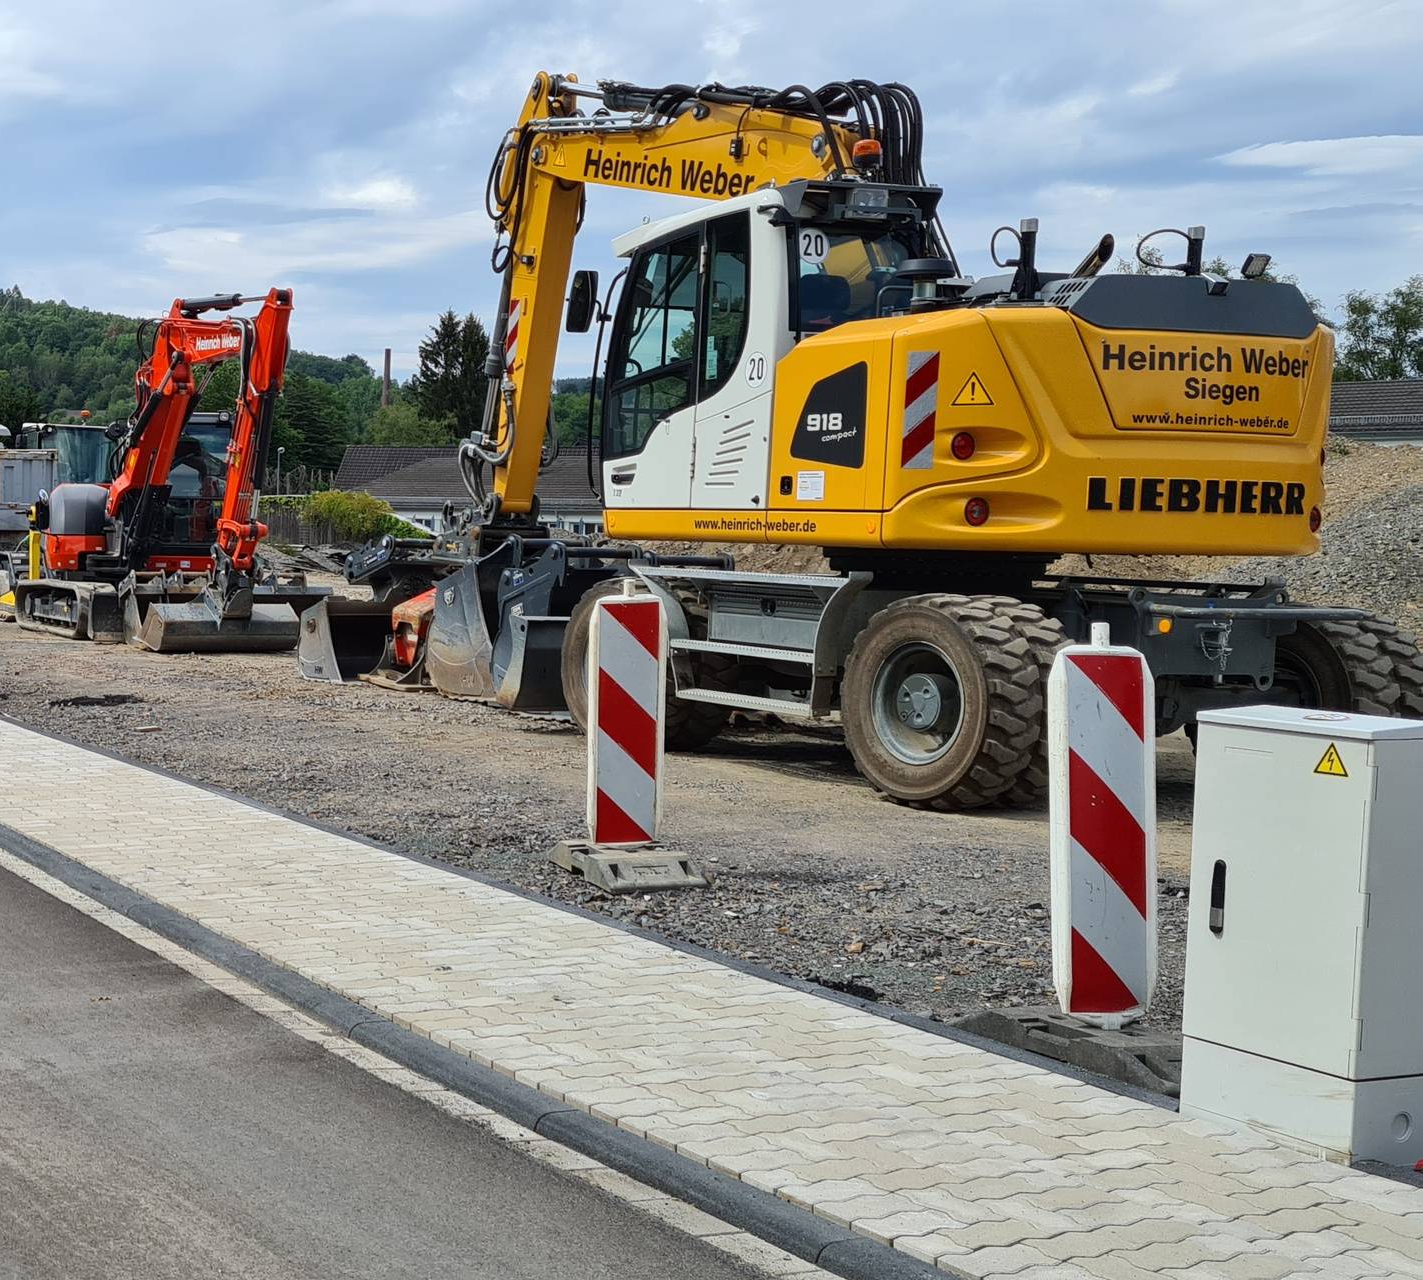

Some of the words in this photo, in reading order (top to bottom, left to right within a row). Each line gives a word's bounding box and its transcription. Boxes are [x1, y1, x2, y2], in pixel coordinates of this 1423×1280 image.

[584, 148, 673, 188] Heinrich
[680, 159, 755, 198] Weber
[802, 233, 824, 257] 20
[748, 357, 764, 381] 20
[1102, 344, 1232, 372] Heinrich
[1241, 347, 1309, 378] Weber
[1184, 377, 1260, 405] Siegen
[806, 413, 843, 431] 918
[1132, 412, 1290, 429] www.heinrich-weber.de
[821, 427, 857, 442] compact
[1087, 476, 1306, 516] LIEBHERR
[694, 518, 817, 532] www.heinrich-weber.de
